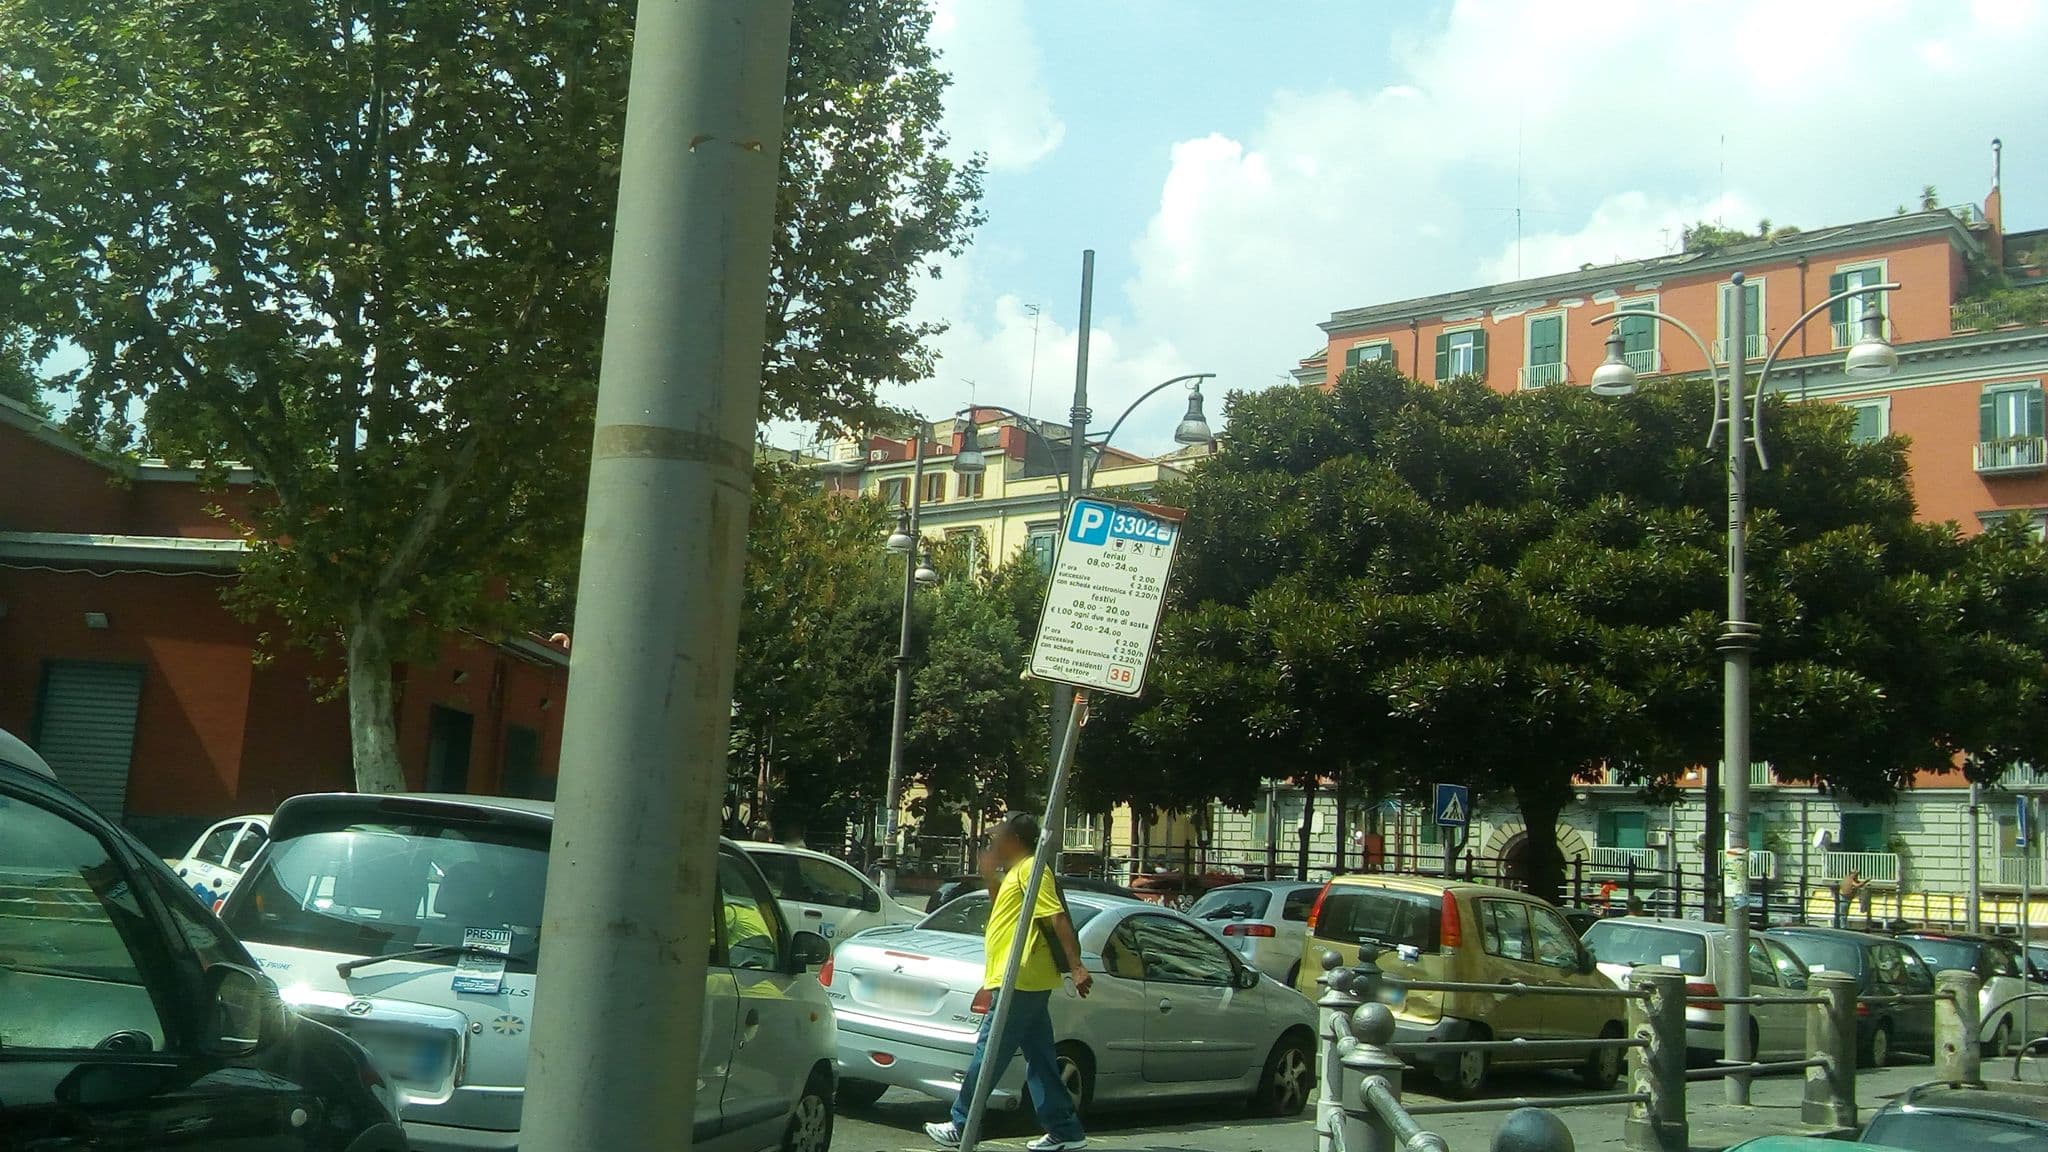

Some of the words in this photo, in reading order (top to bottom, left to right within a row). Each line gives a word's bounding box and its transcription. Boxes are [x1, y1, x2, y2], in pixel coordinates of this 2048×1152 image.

[1078, 507, 1104, 538] P
[1113, 515, 1158, 538] 3302
[1103, 551, 1127, 561] feriali
[1059, 571, 1091, 581] successive
[1069, 580, 1091, 589] scheda
[1091, 593, 1117, 604] festivi
[1074, 611, 1090, 620] ogni
[1091, 613, 1104, 621] due
[1106, 616, 1118, 624] ore
[1120, 618, 1128, 626] di
[1129, 621, 1149, 630] sosta
[1042, 634, 1074, 644] successive
[1053, 644, 1074, 652] scheda
[1045, 655, 1070, 665] eccetto
[1072, 660, 1103, 671] residenti
[1065, 667, 1090, 677] settore
[466, 929, 510, 940] PRESTITI
